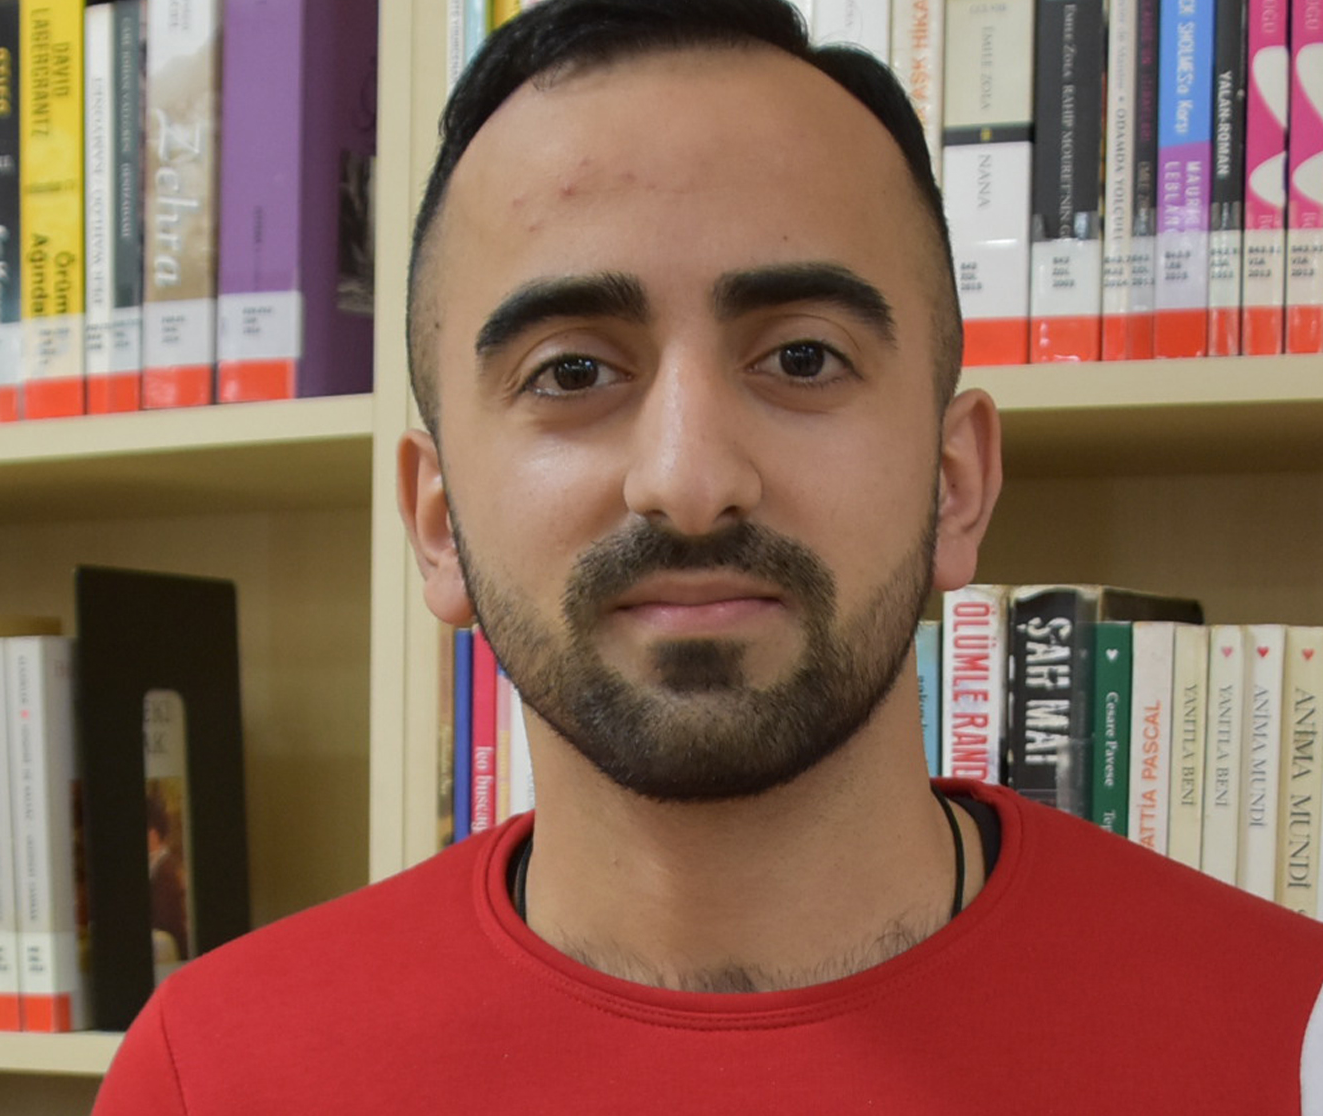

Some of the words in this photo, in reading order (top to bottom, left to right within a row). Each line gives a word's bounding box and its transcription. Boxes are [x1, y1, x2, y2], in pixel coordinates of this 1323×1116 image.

[1115, 108, 1127, 173] ODAMDA
[153, 108, 201, 288] Zehra
[978, 154, 992, 208] NANA
[952, 601, 997, 703] ÖLÜMLE
[1016, 616, 1072, 690] ŞAH
[1104, 692, 1120, 738] Cesare
[1141, 700, 1162, 781] PASCAL
[1183, 684, 1199, 763] YANITLA
[1216, 685, 1233, 763] YANITLA
[1251, 686, 1272, 753] ANİMA
[1291, 689, 1318, 782] ANİMA
[1103, 740, 1119, 787] Pavese
[1181, 767, 1197, 807] BENİ
[1215, 767, 1230, 807] BENİ
[1249, 759, 1271, 829] MUNDİ
[1287, 794, 1313, 890] MUNDİ
